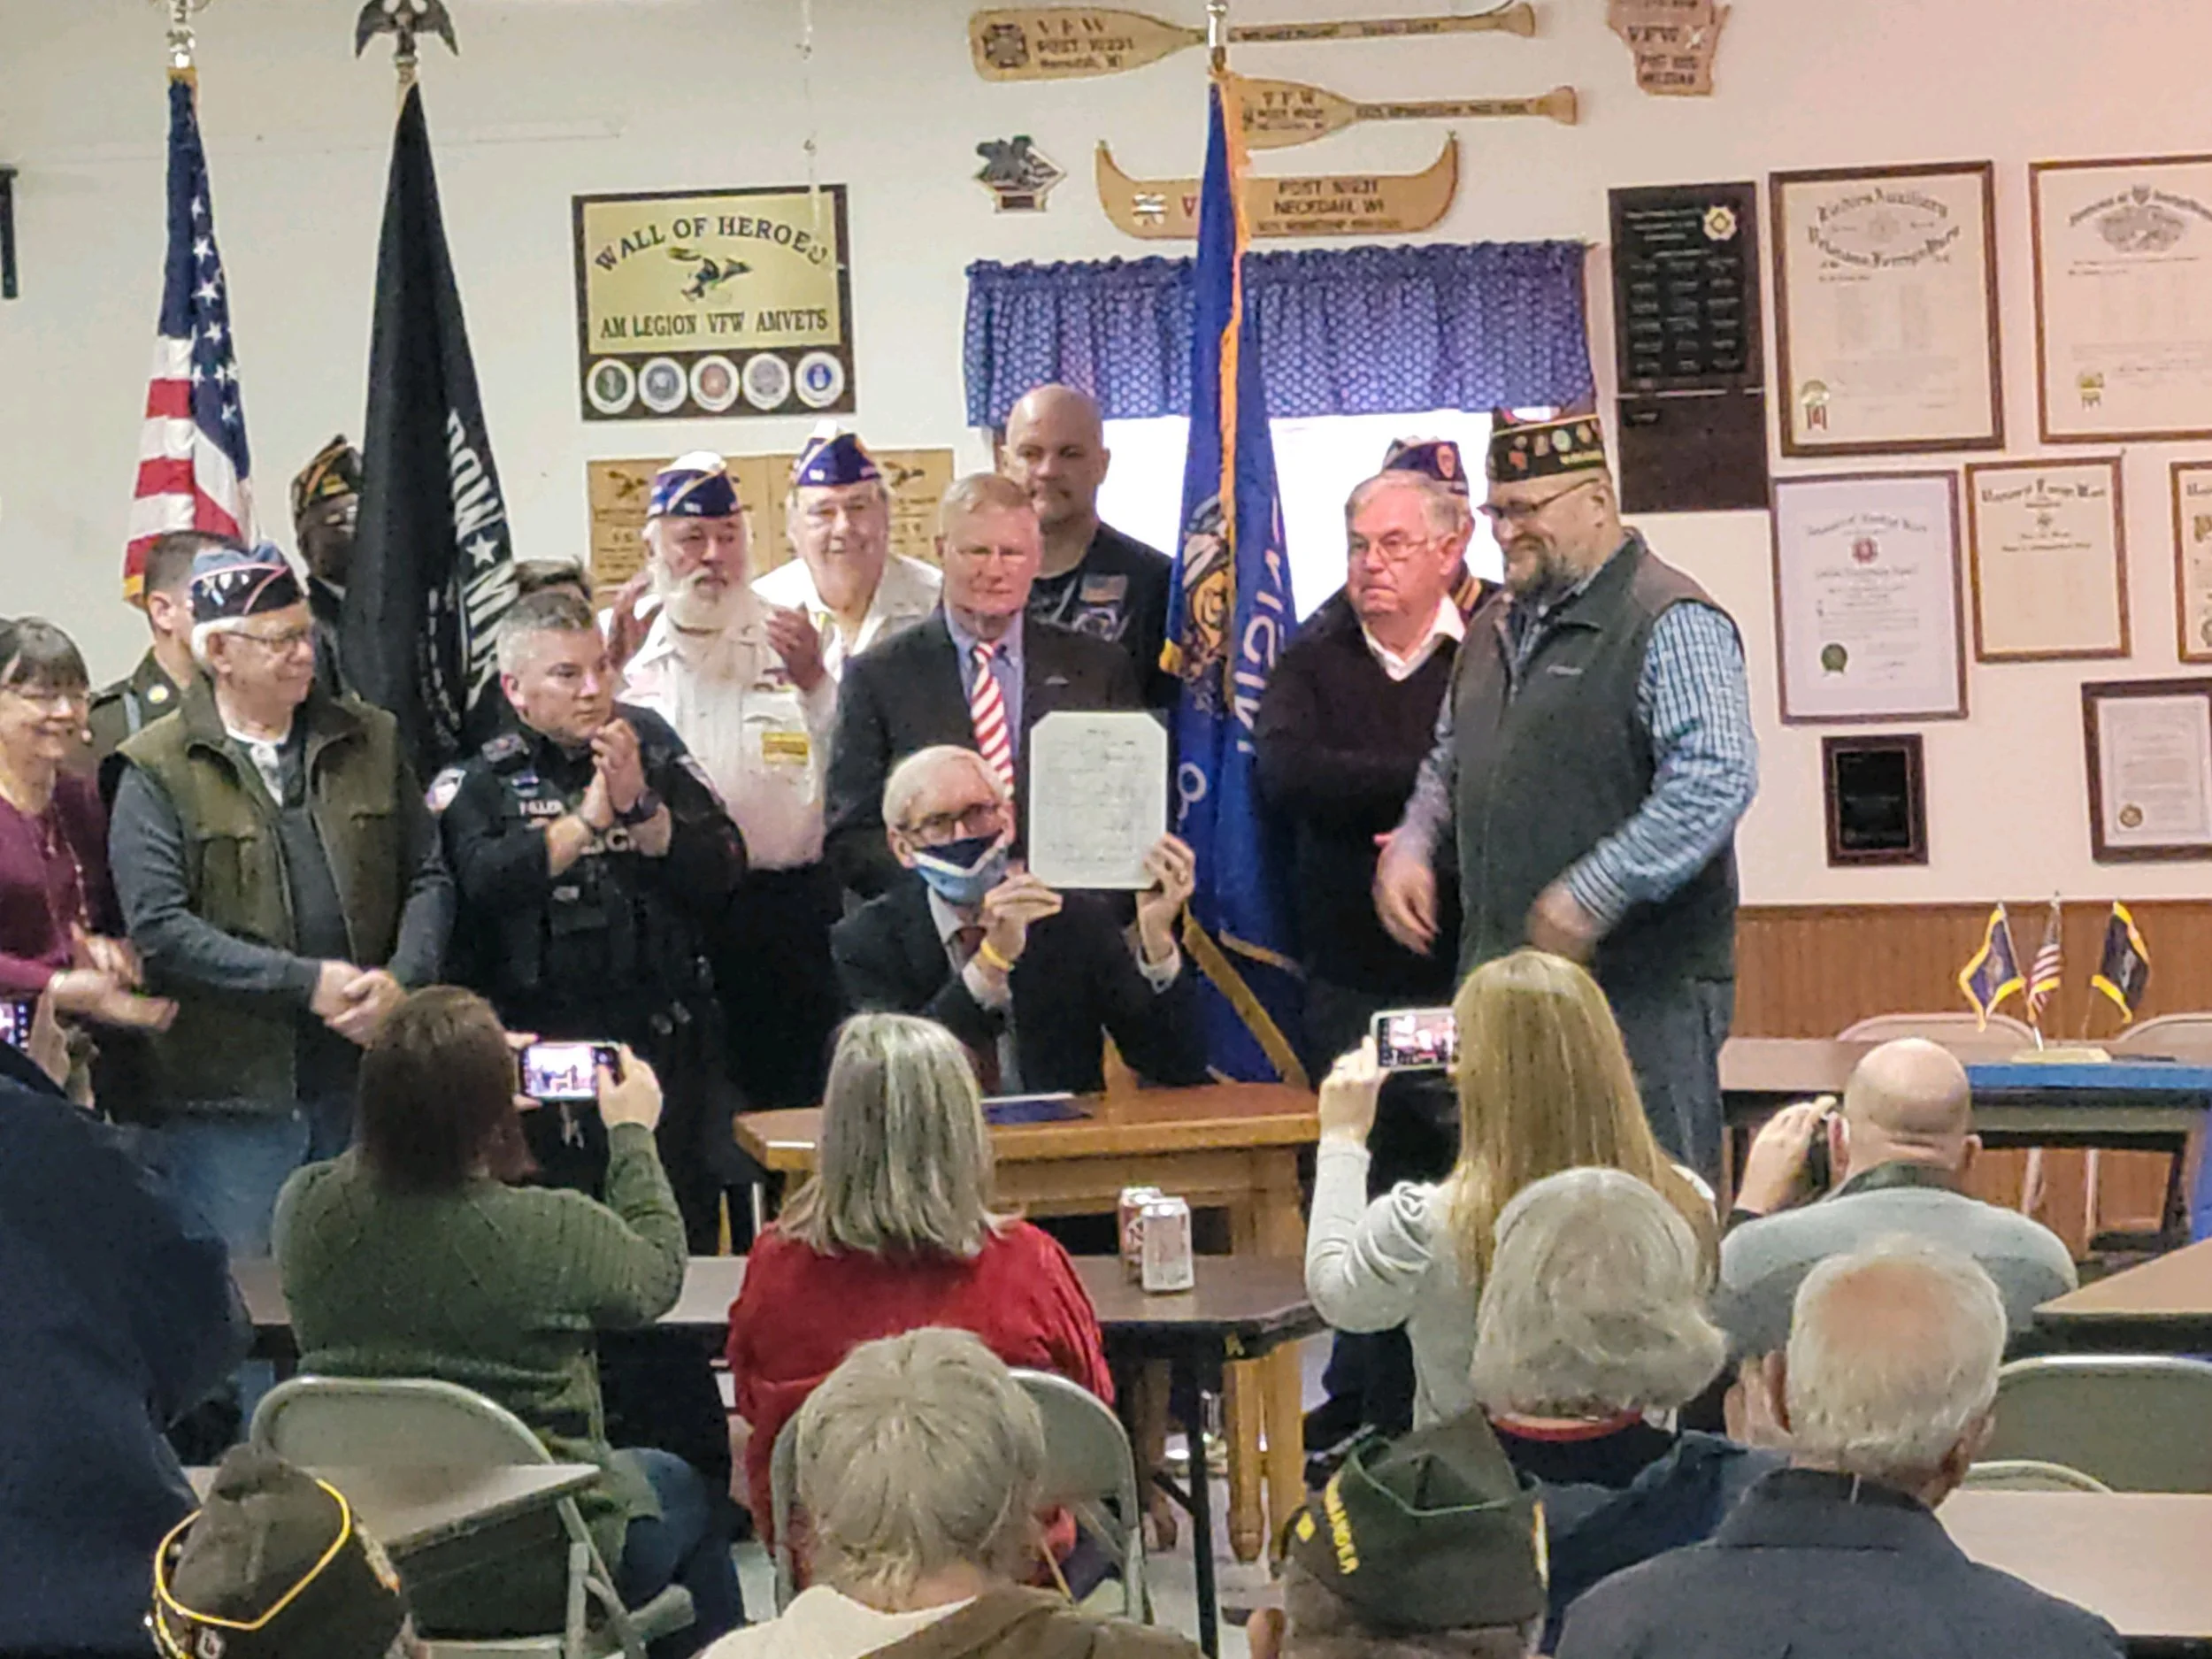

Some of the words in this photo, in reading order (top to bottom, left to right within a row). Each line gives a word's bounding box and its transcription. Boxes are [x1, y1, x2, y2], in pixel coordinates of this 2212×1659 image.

[595, 225, 666, 272] WALL
[672, 218, 708, 240] OF
[600, 317, 627, 338] AM
[632, 314, 697, 338] LEGION
[707, 311, 745, 334] VFW
[756, 309, 829, 332] AMVETS
